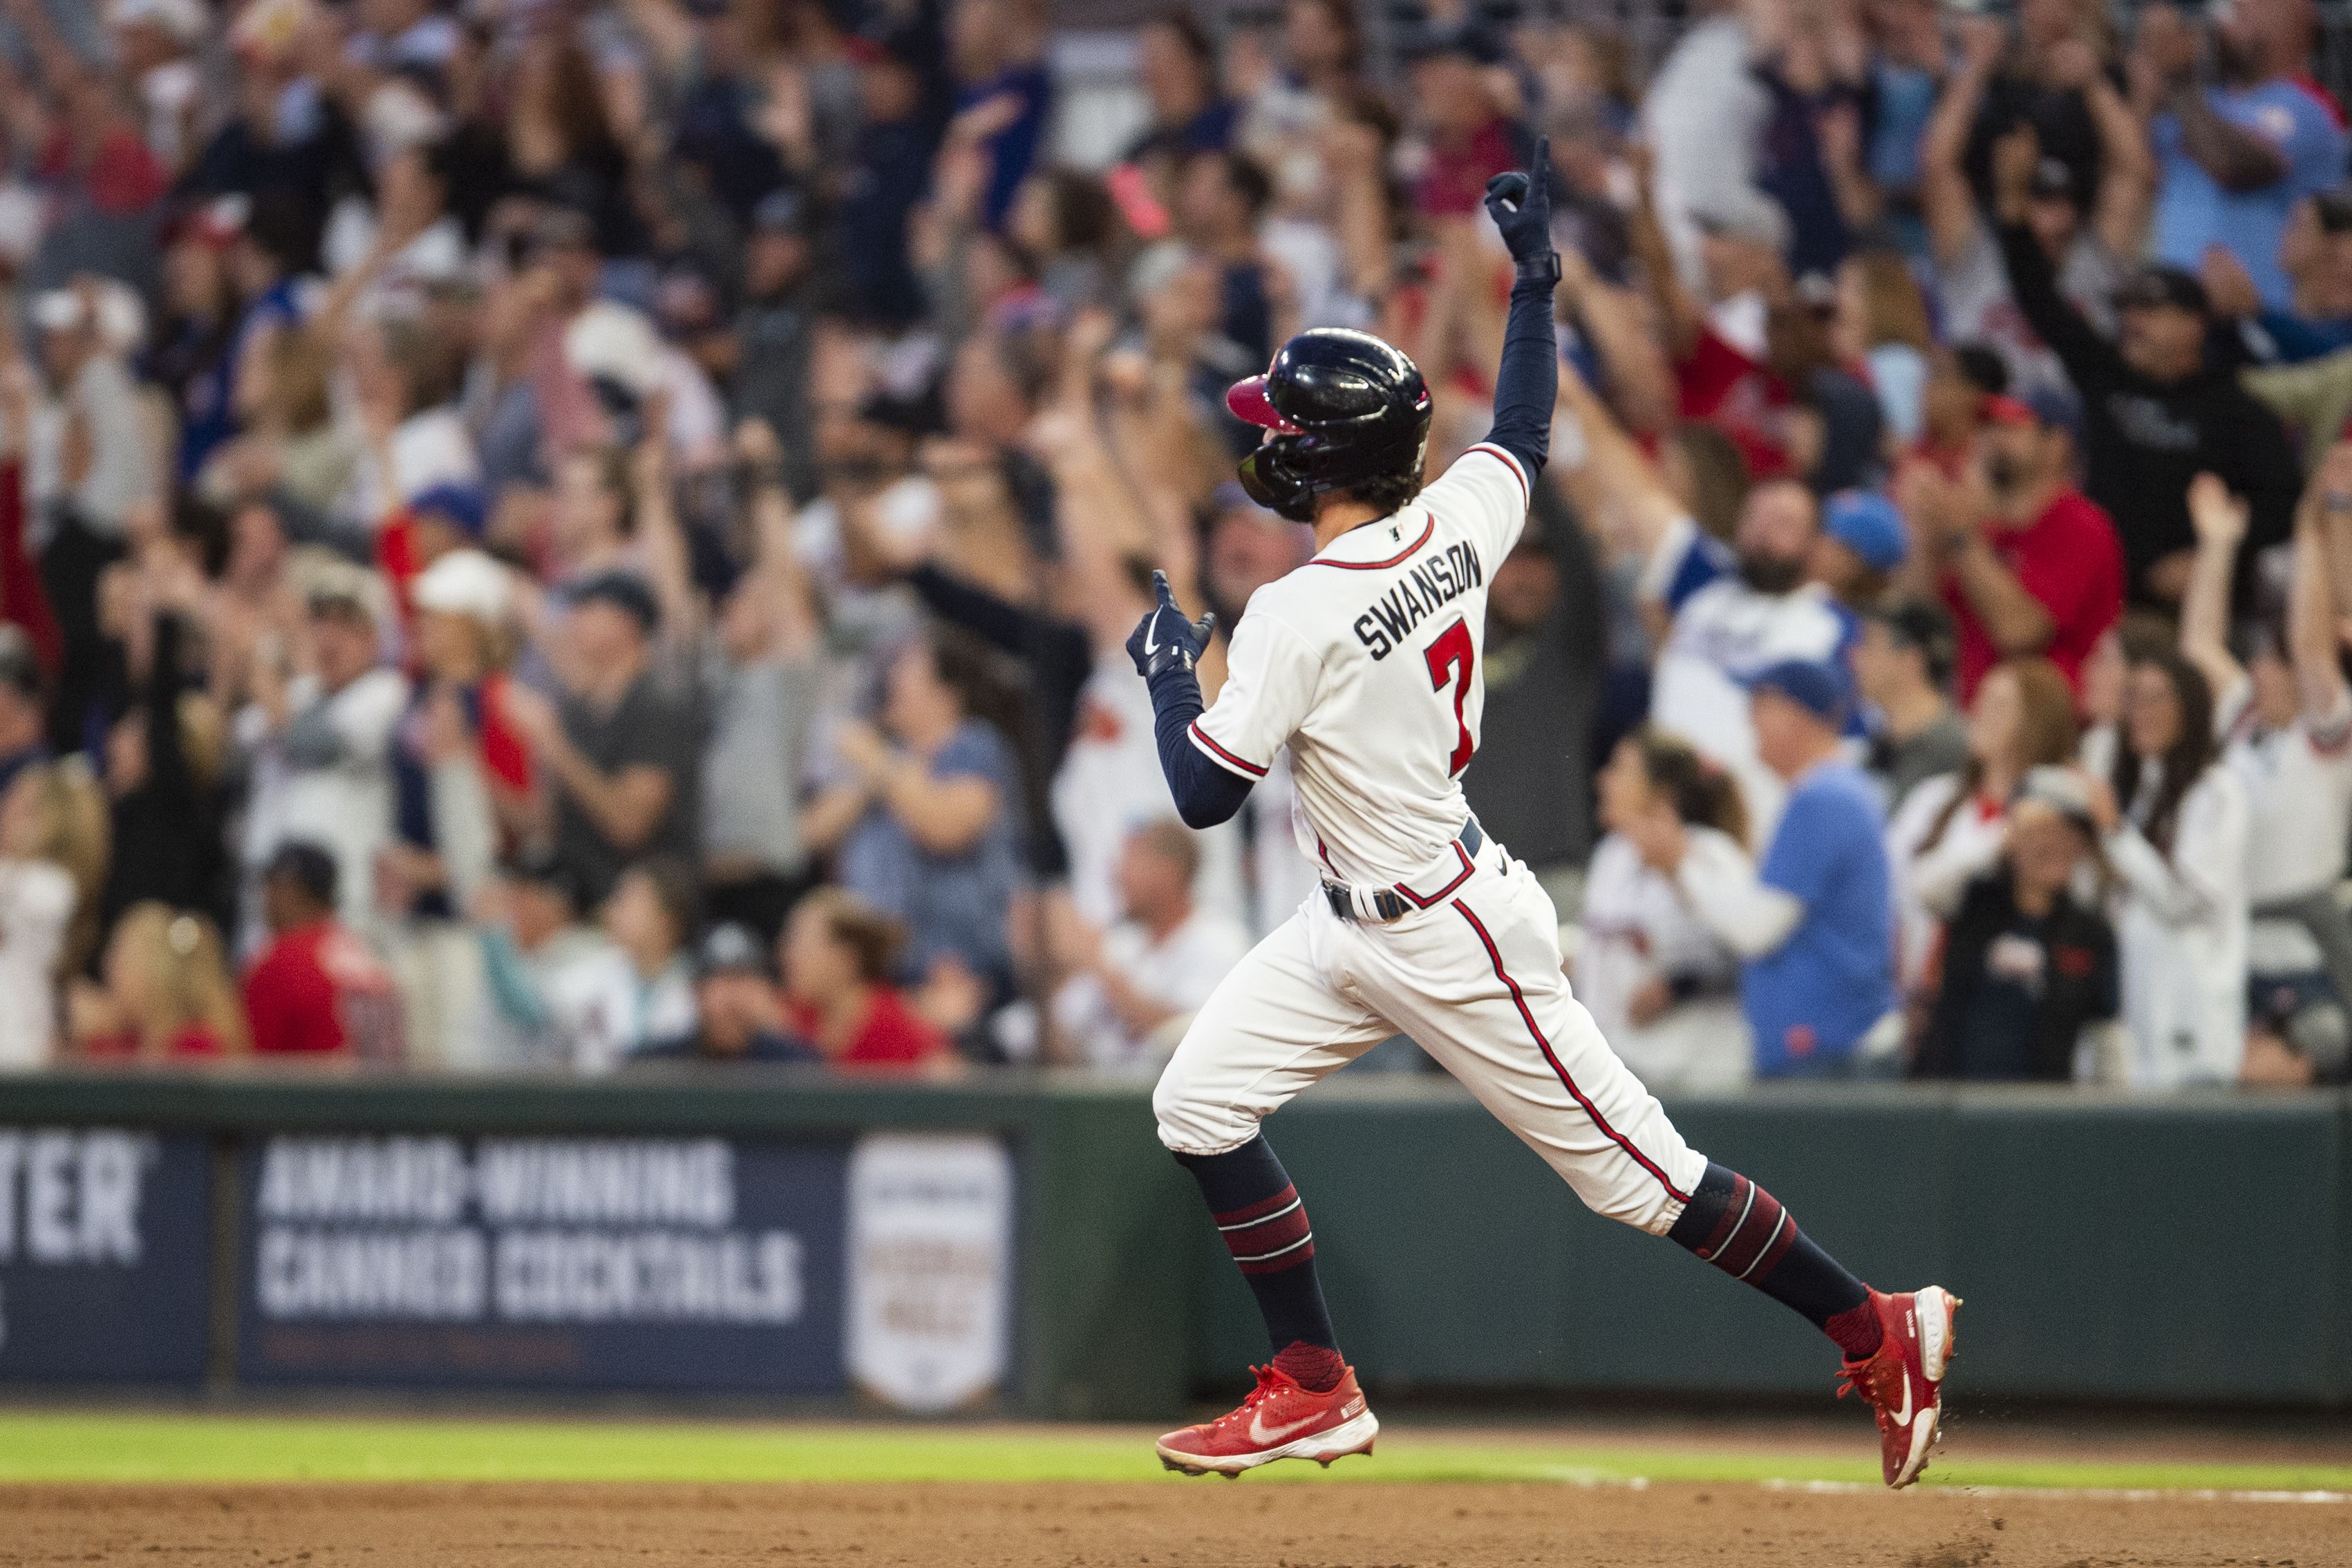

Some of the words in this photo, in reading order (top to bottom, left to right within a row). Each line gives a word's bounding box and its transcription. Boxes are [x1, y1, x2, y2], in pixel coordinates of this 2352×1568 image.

[1353, 539, 1482, 661] SWANSON
[1423, 616, 1474, 779] 7
[263, 1139, 733, 1226] AWARD-WINNING
[261, 1230, 482, 1319] CANNED
[498, 1231, 802, 1321] COCKTAILS
